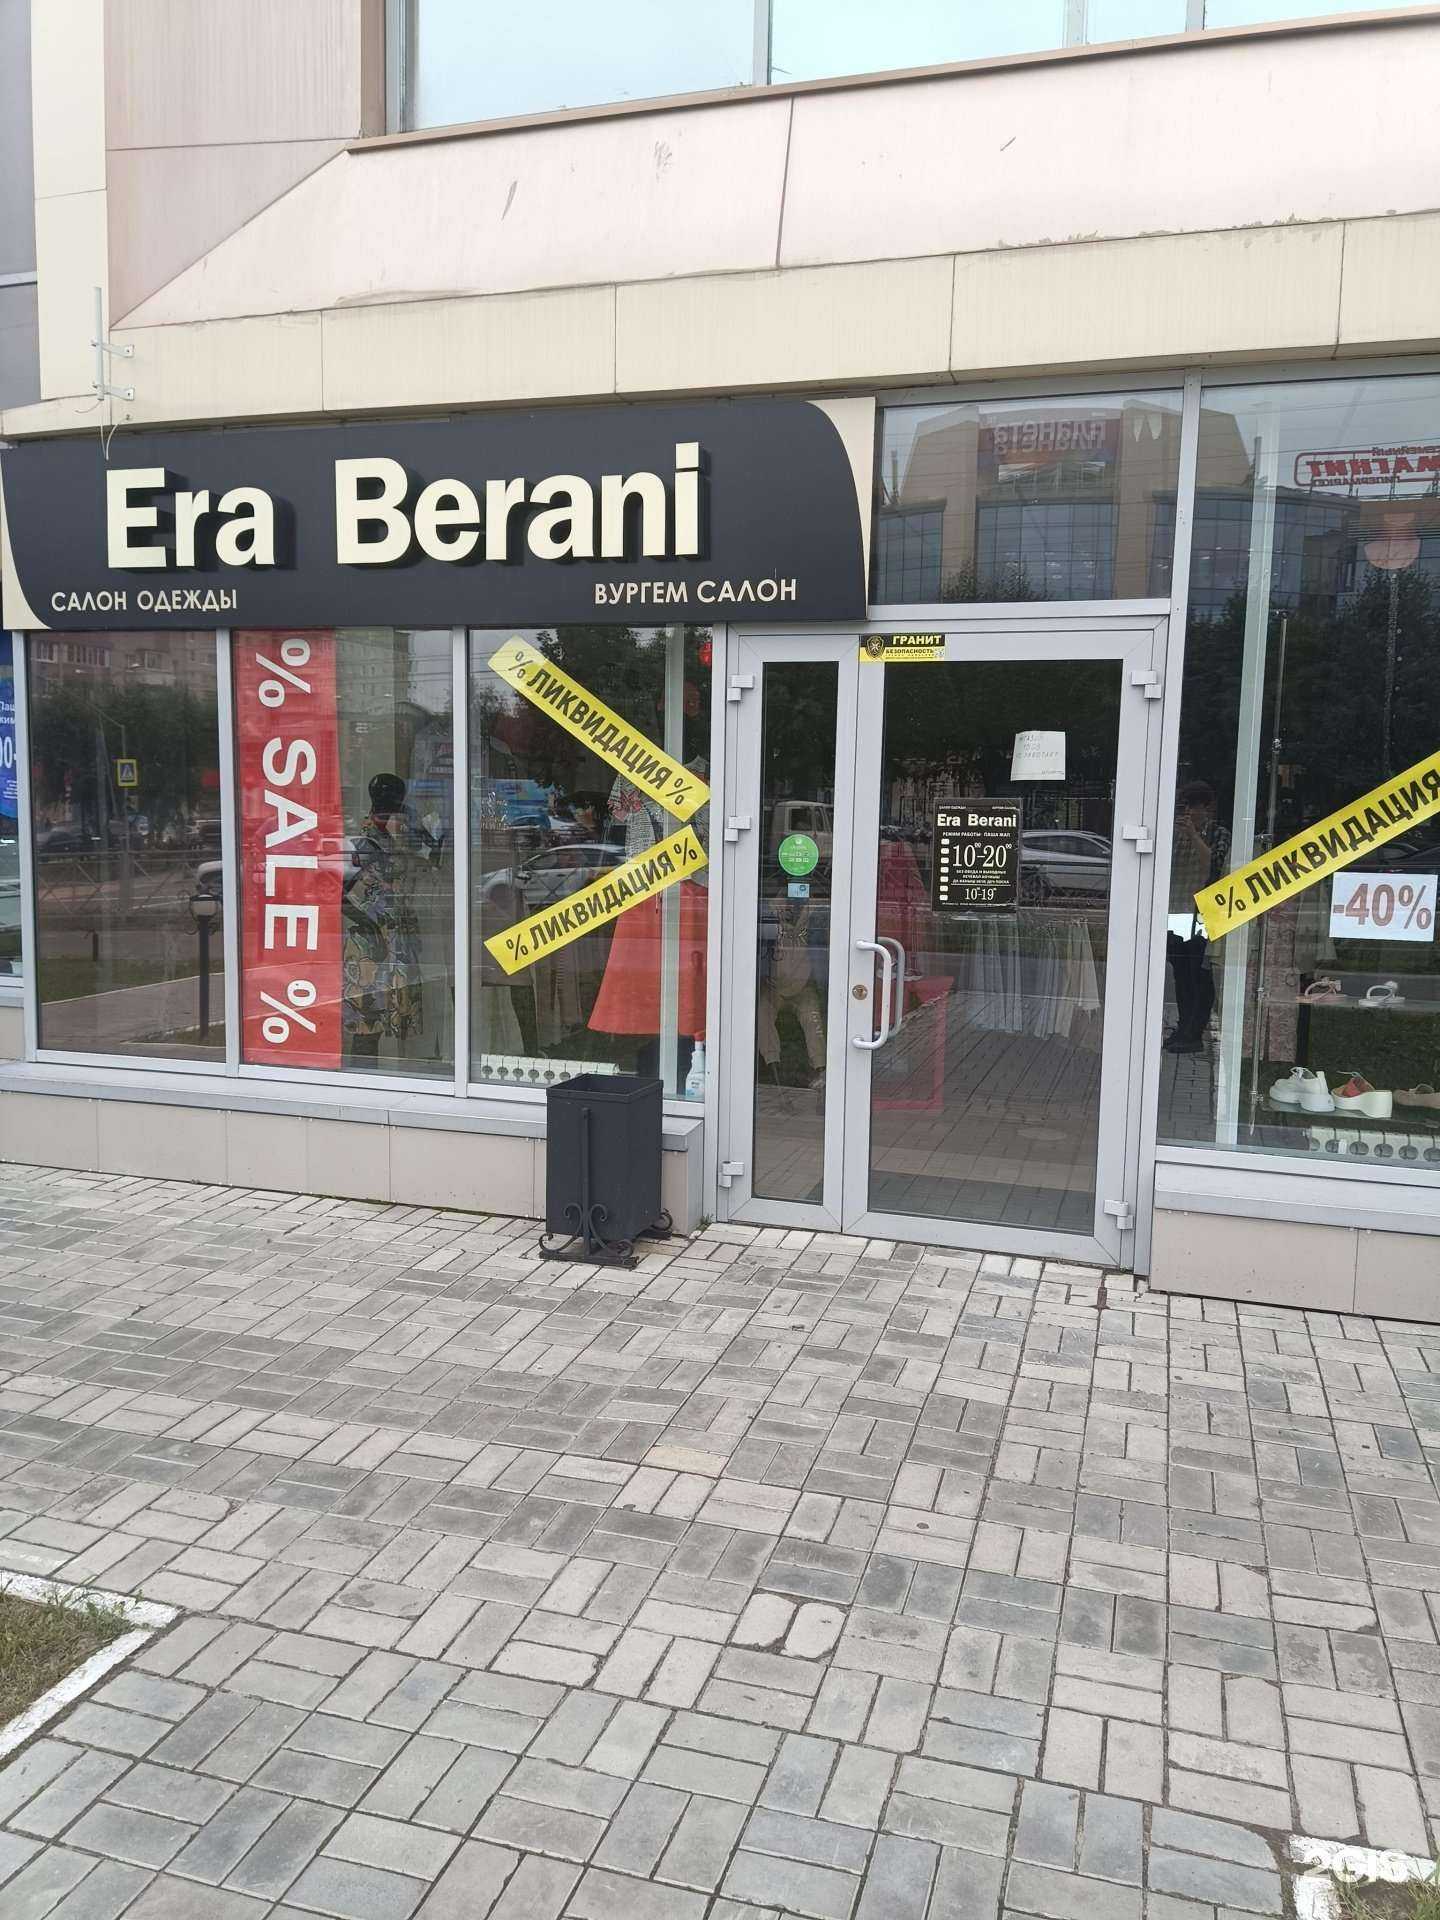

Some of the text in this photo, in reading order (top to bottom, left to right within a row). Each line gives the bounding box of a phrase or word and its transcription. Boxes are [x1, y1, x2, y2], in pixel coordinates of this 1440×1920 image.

[106, 441, 700, 568] Era Berani
[51, 588, 237, 613] САЛОН ОДЕЖДЫ
[594, 578, 797, 605] ВУРГЕМ САЛОН
[892, 635, 942, 645] ГРАНИТ
[526, 667, 674, 789] ЛИКВИДАЦИЯ
[262, 736, 320, 952] SALE
[937, 813, 1017, 827] Era Berani
[1244, 768, 1440, 905] ЛИКВИДАЦИЯ
[529, 850, 677, 952] ЛИКВИДАЦИЯ
[1332, 883, 1433, 931] -40%
